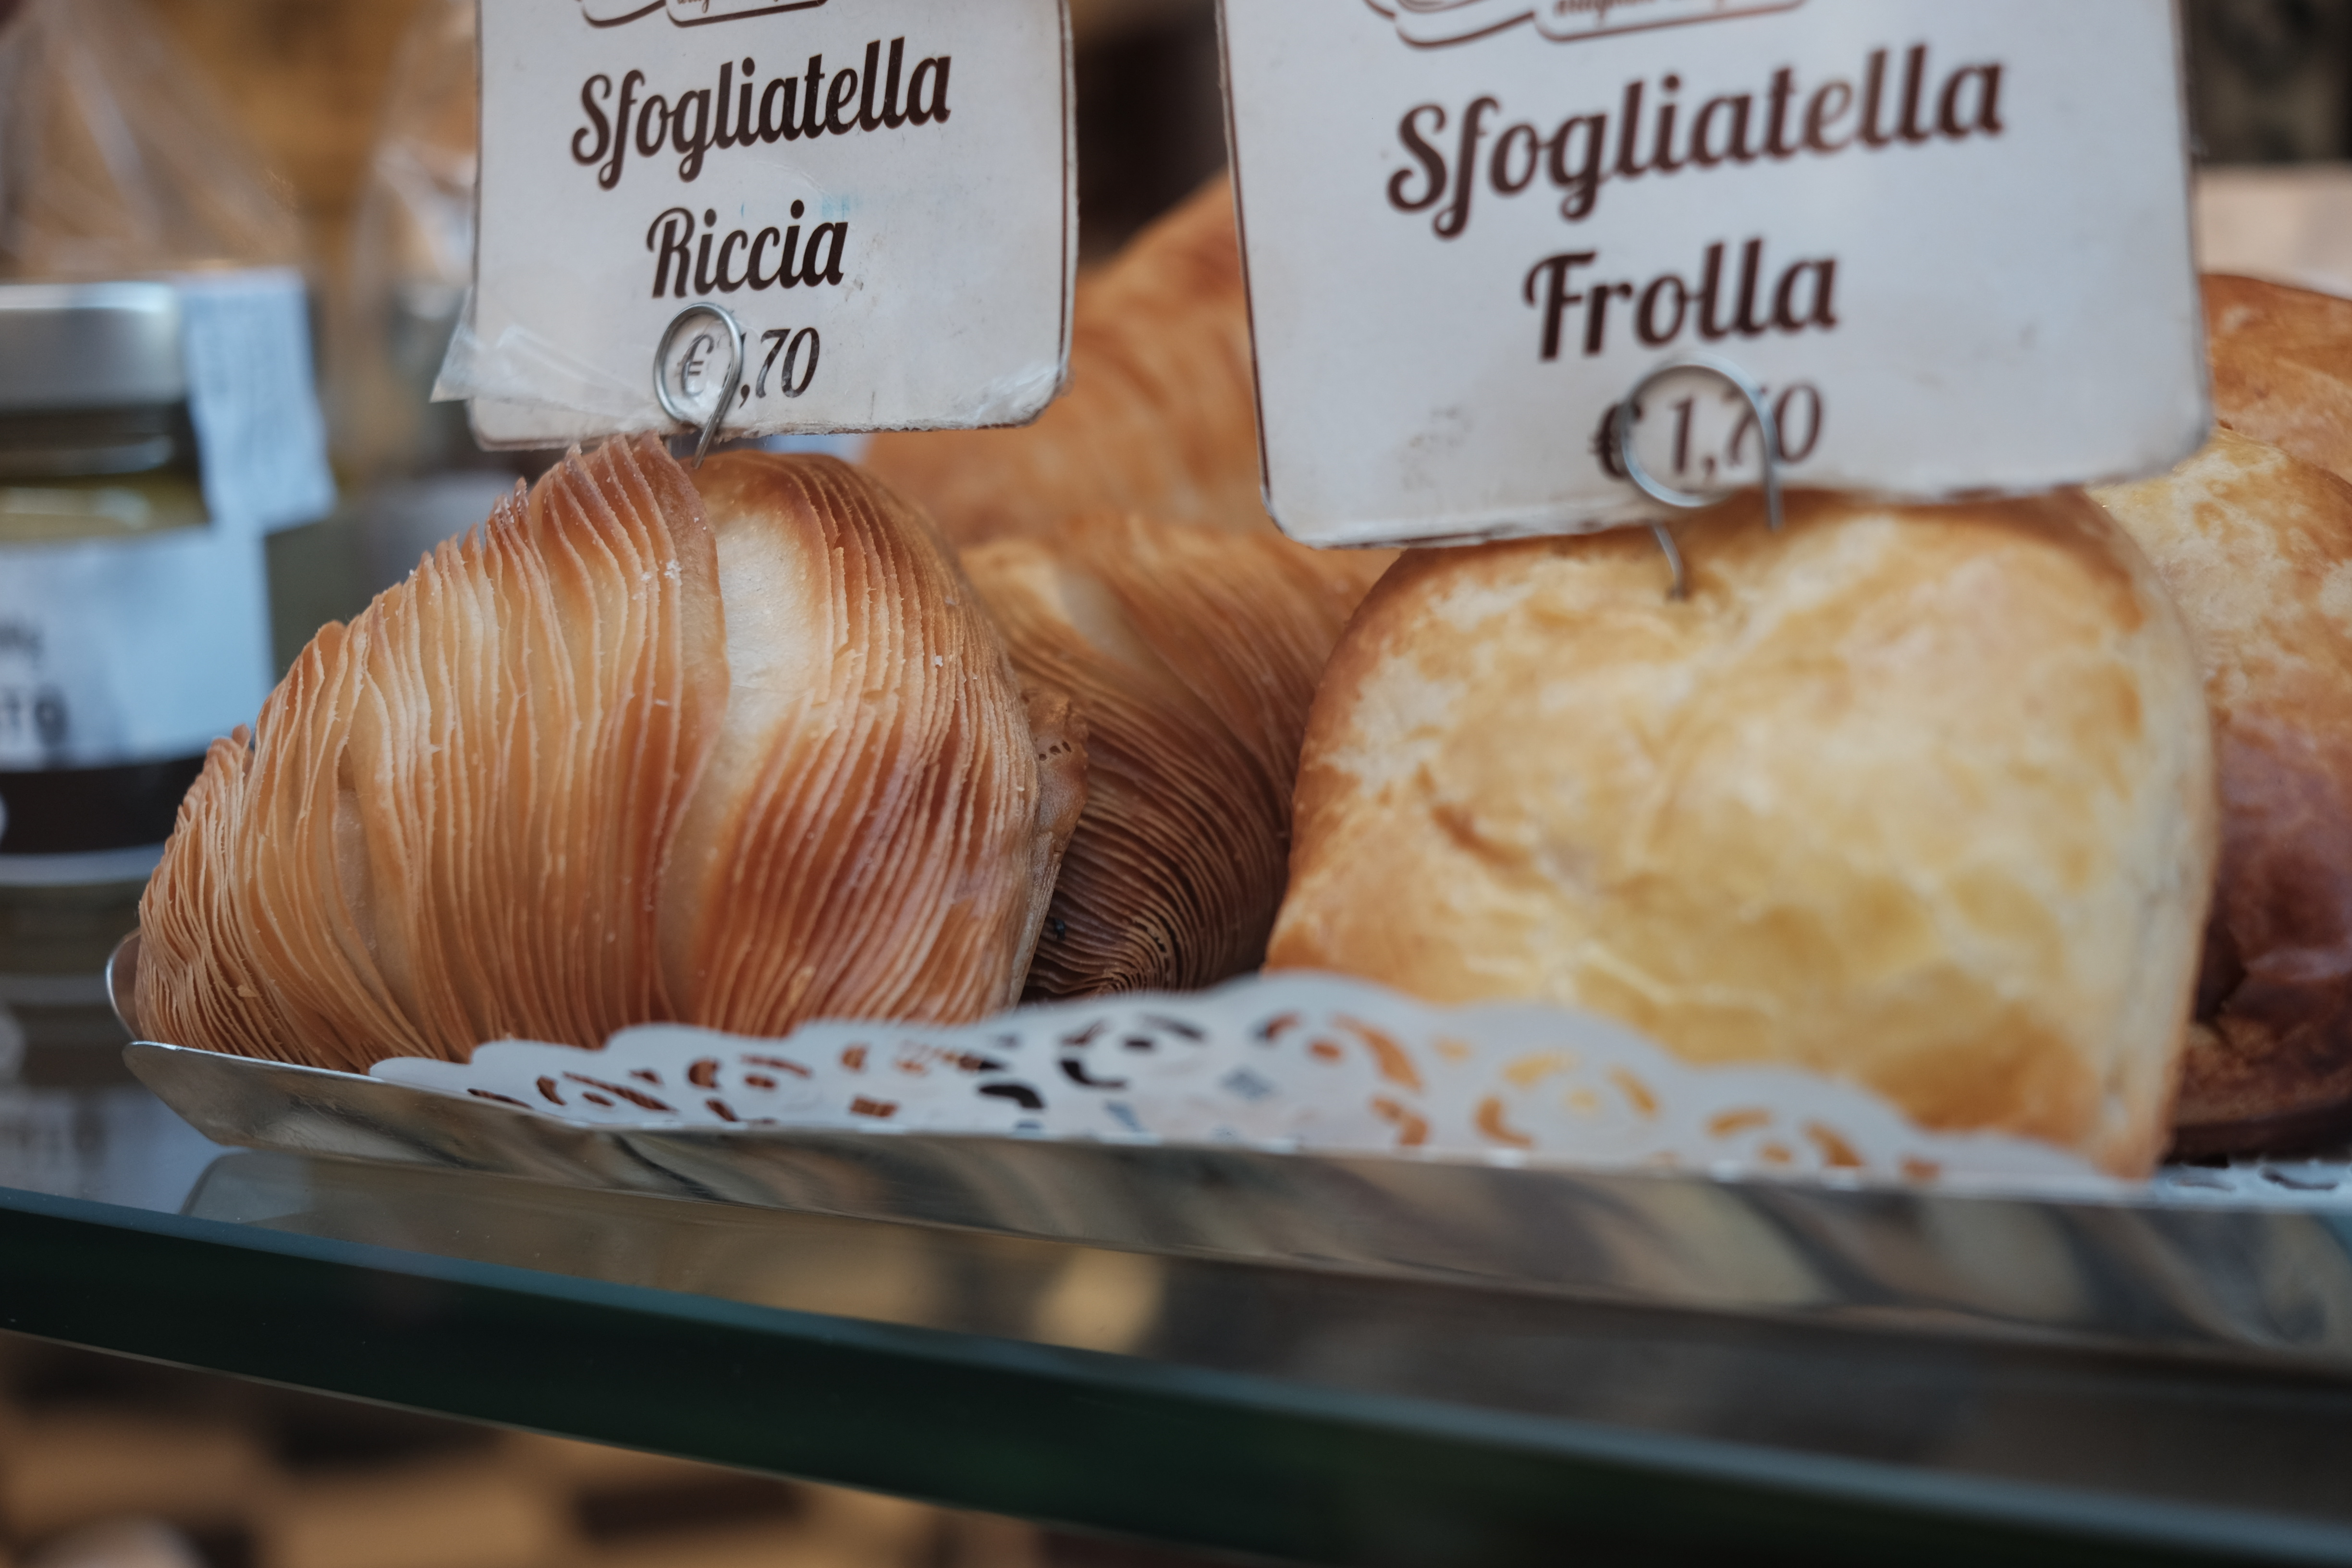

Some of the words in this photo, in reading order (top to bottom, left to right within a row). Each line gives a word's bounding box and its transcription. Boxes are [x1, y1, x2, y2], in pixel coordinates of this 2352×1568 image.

[571, 36, 952, 190] Sfogliatella
[1386, 43, 2004, 240] Sfogliatella
[646, 199, 848, 298] Riccia
[1522, 237, 1838, 363] Frolla
[723, 327, 820, 409] ,70
